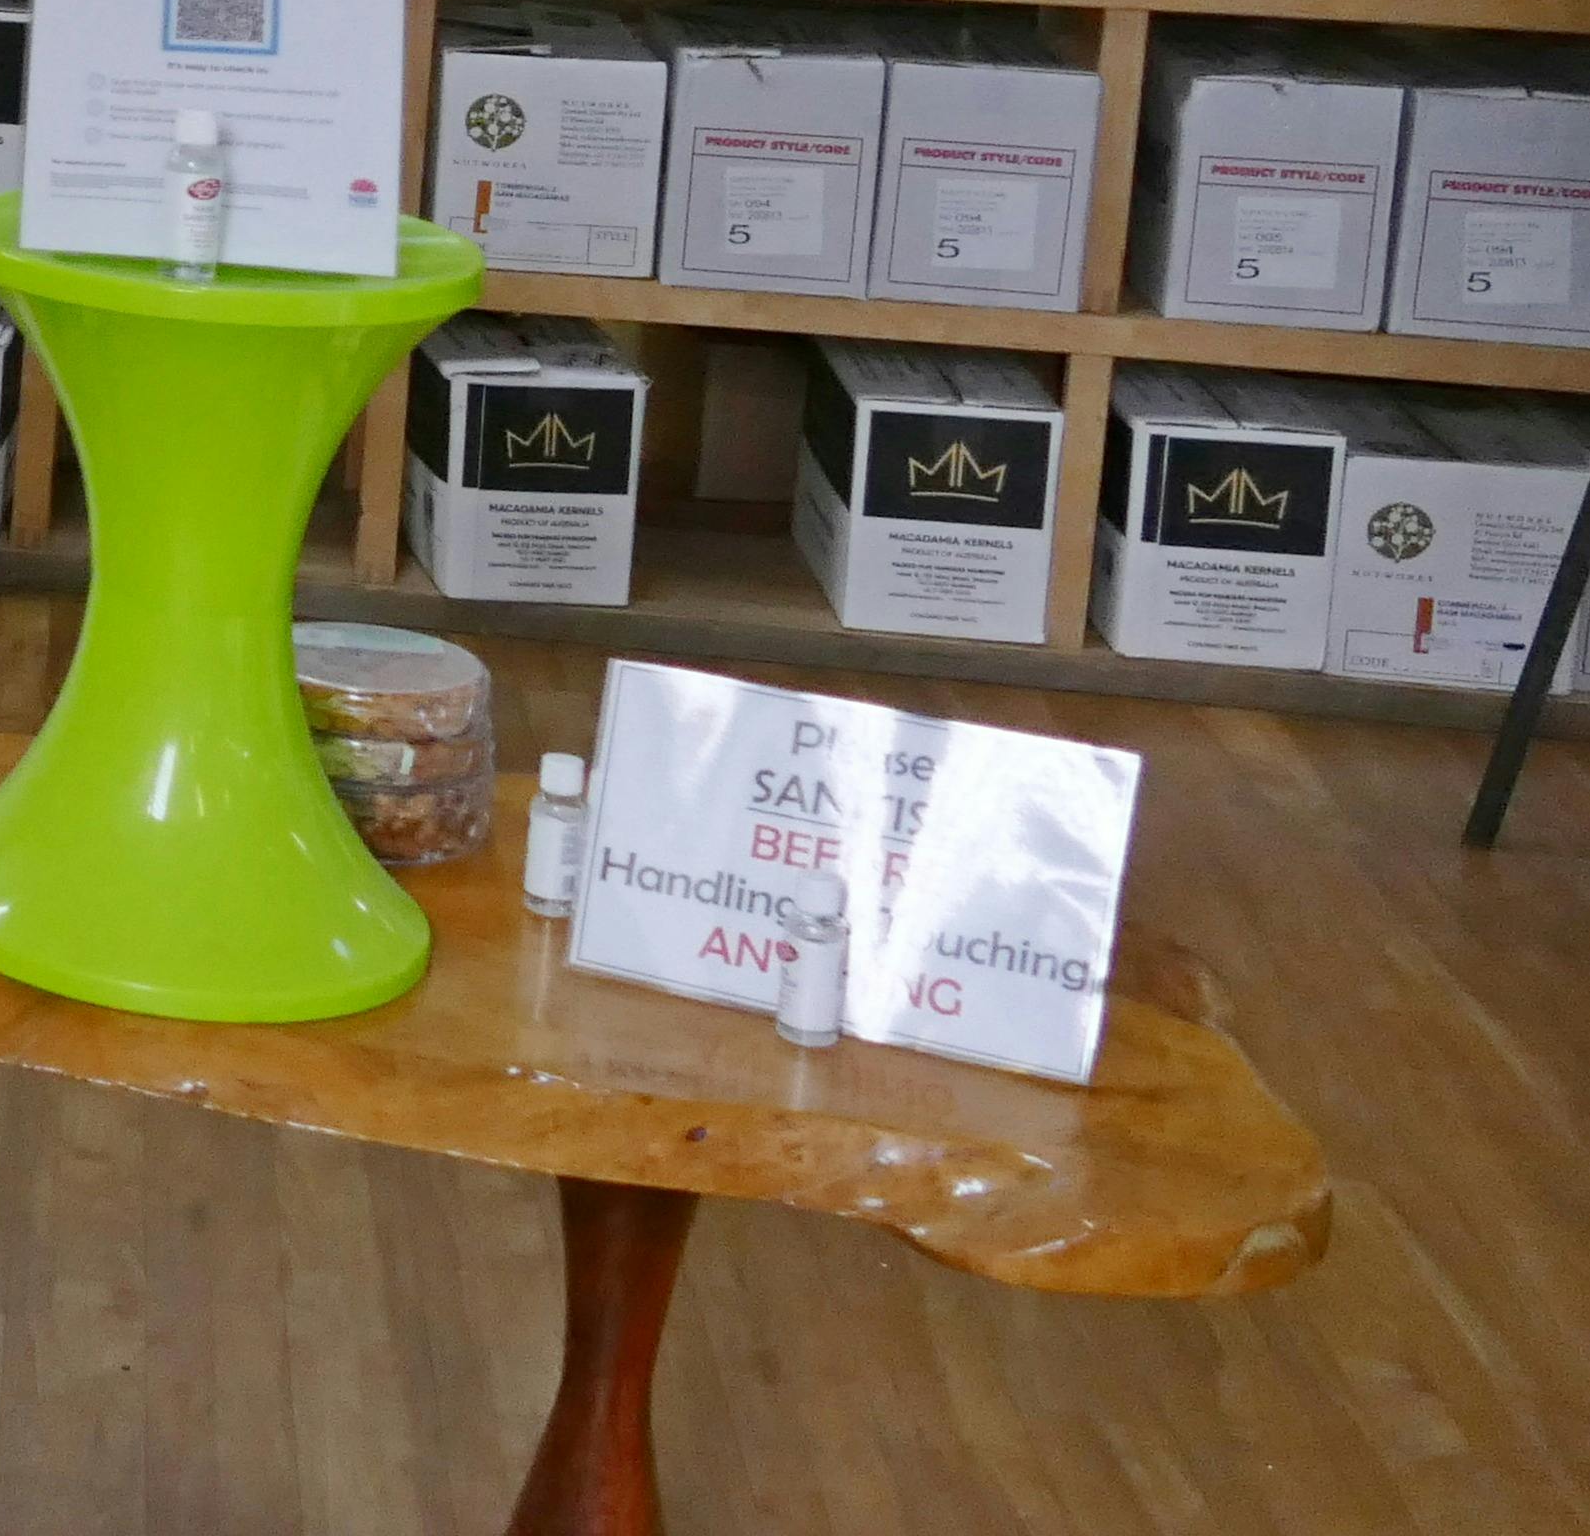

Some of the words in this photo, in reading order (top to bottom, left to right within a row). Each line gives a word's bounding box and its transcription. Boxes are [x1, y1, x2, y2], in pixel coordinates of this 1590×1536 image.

[704, 135, 767, 150] PRODUCT
[770, 139, 852, 156] STYLE/CODE
[913, 146, 977, 162] PRODUCT
[1210, 163, 1277, 179] PRODUCT
[1280, 168, 1367, 184] STYLE/CODE
[1441, 179, 1510, 195] PRODUCT
[1512, 183, 1590, 200] STYLE/COD
[727, 223, 752, 245] 5
[936, 237, 961, 259] 5
[1235, 258, 1261, 280] 5
[1466, 270, 1493, 293] 5
[488, 501, 557, 517] MACADAMIA
[558, 504, 605, 517] KERNELS
[1165, 558, 1242, 575] MACADAMIA
[1243, 564, 1297, 578] KERNELS
[791, 720, 937, 783] Plse
[750, 823, 912, 889] BEFR
